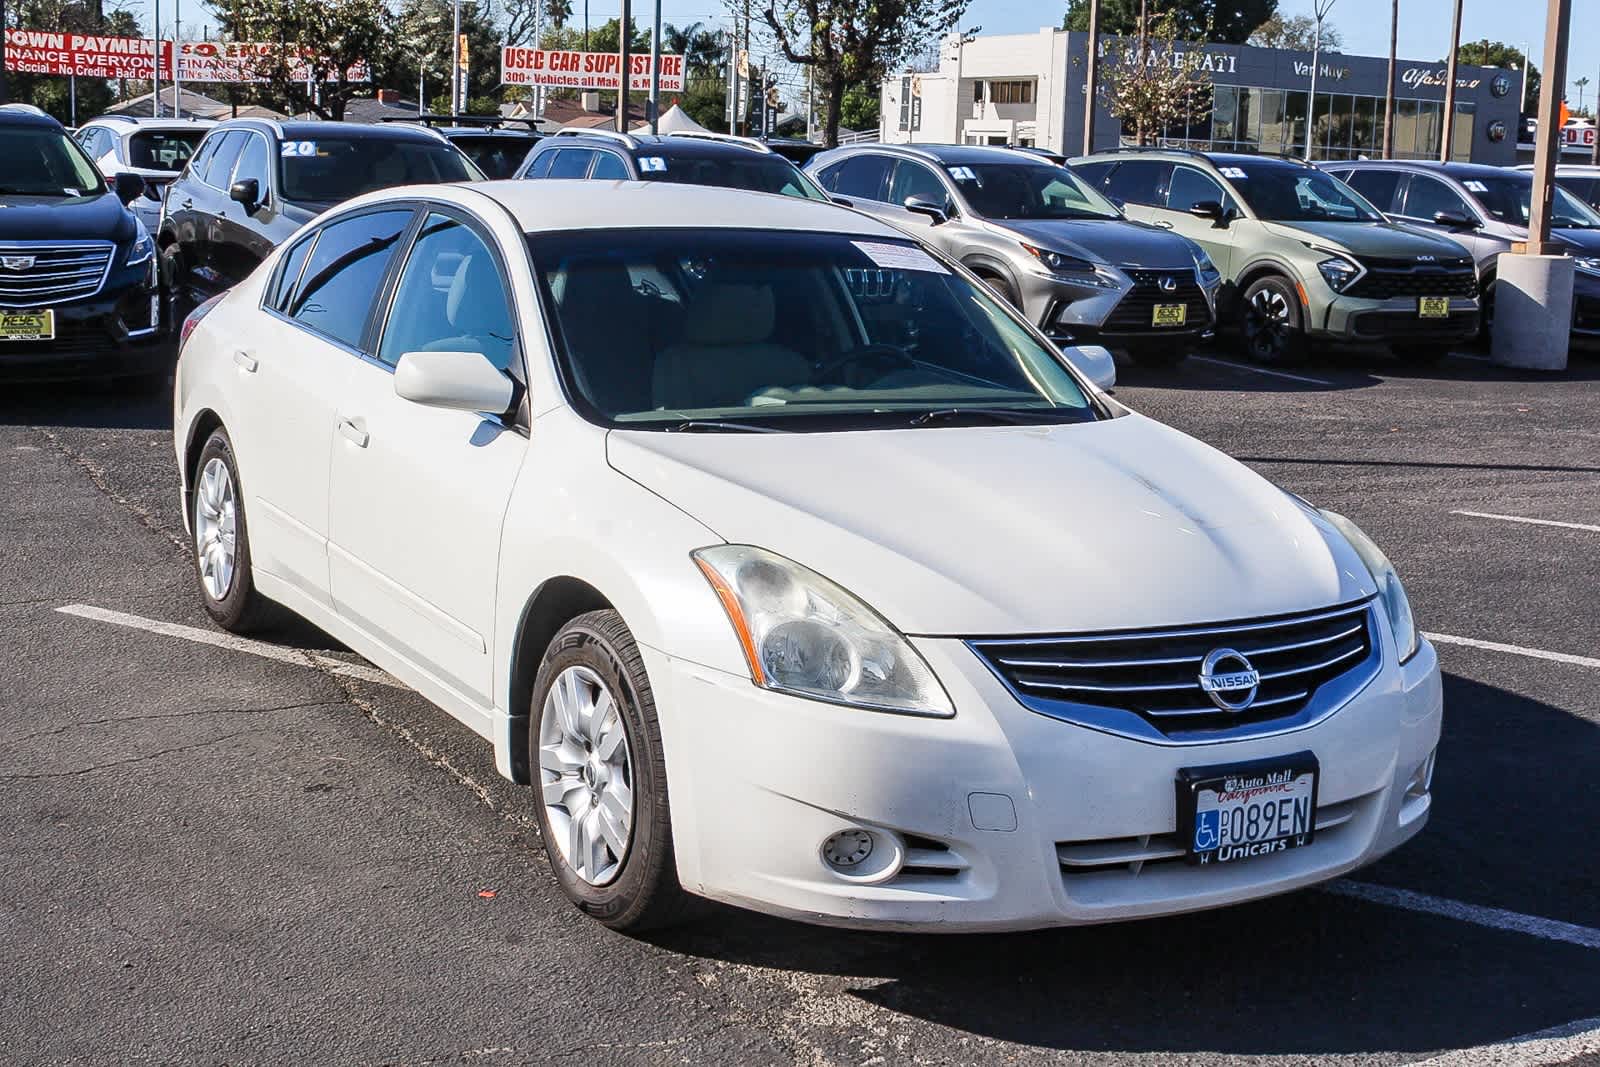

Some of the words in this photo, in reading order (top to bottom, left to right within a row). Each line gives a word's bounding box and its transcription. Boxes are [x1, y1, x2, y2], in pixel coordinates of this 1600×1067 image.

[71, 35, 167, 56] PAYMENT
[5, 47, 70, 63] INANCE
[75, 53, 167, 69] EVERYONE
[505, 46, 544, 70] USED
[549, 51, 581, 73] CAR
[17, 61, 50, 74] Social
[58, 63, 74, 75] No
[76, 64, 108, 78] Credit
[116, 67, 136, 79] Bad
[1293, 61, 1315, 76] Van
[1320, 65, 1351, 81] Nuys
[1402, 68, 1434, 90] Alfa
[505, 72, 532, 84] 300+
[534, 73, 579, 87] Vehicles
[581, 75, 594, 87] all
[597, 76, 624, 88] Mak
[632, 79, 640, 88] &
[642, 79, 680, 90] Mdels
[281, 141, 316, 157] 20
[1210, 673, 1257, 689] NISSAN
[1236, 777, 1264, 791] Auto
[1265, 769, 1292, 785] Mall
[1217, 783, 1294, 804] California
[1217, 838, 1288, 862] Unicars
